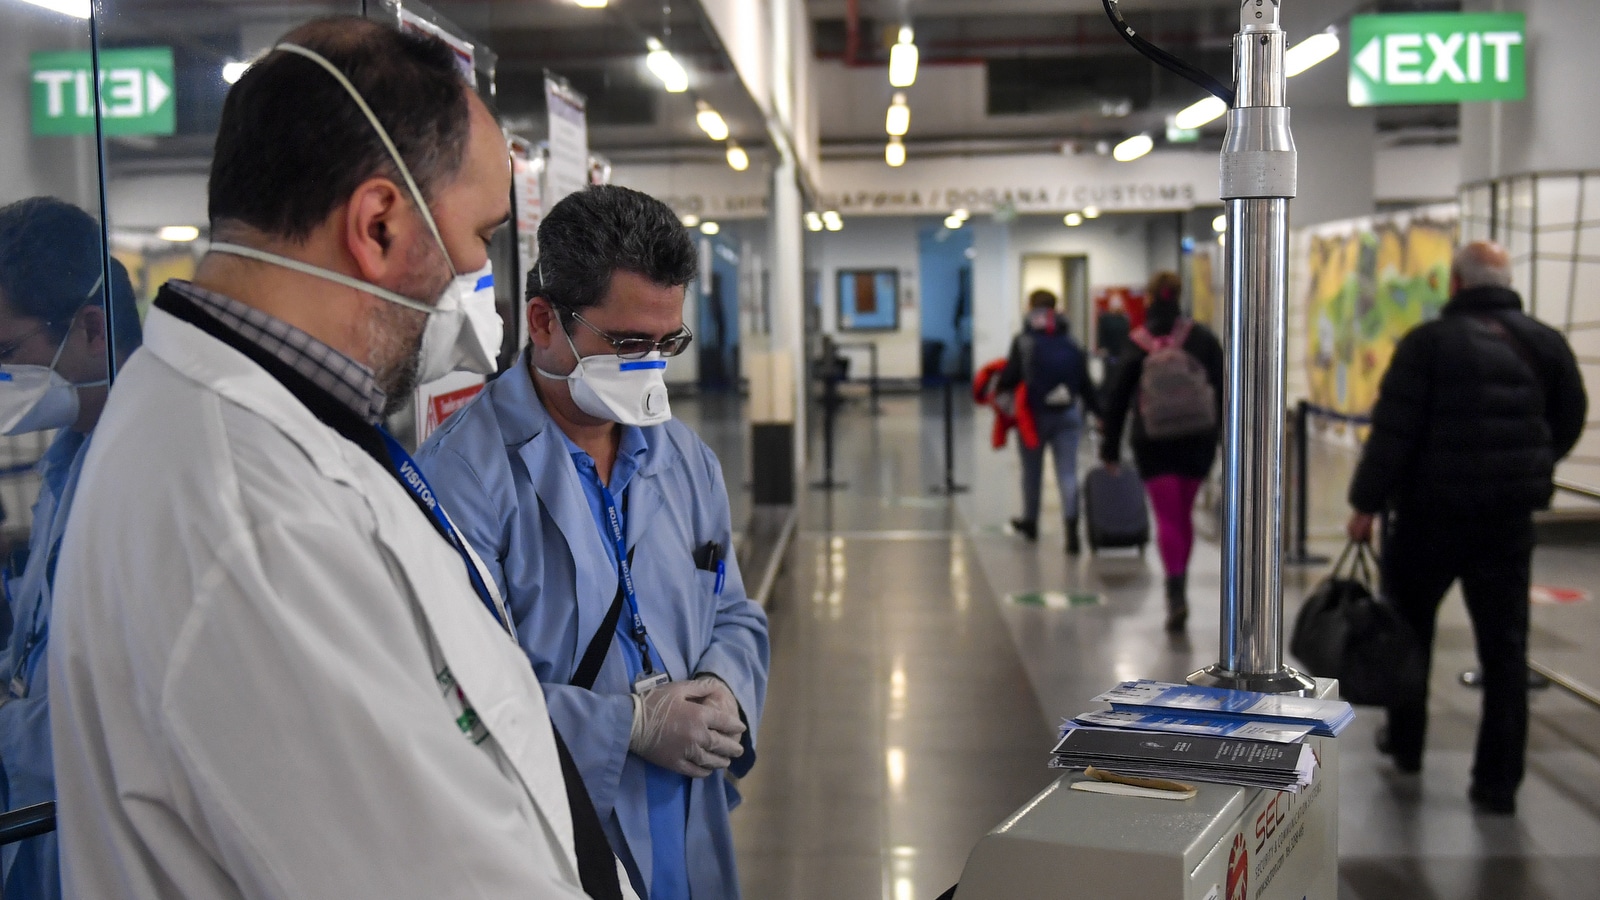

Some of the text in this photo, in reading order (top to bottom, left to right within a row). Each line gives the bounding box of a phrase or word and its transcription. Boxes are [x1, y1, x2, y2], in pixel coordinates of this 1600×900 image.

[1384, 30, 1522, 85] EXIT
[945, 186, 1049, 206] DOGANA
[1073, 183, 1196, 202] CUSTOMS
[400, 460, 438, 511] VISITOR
[608, 505, 622, 542] VISITOR
[621, 559, 635, 596] VISITOR
